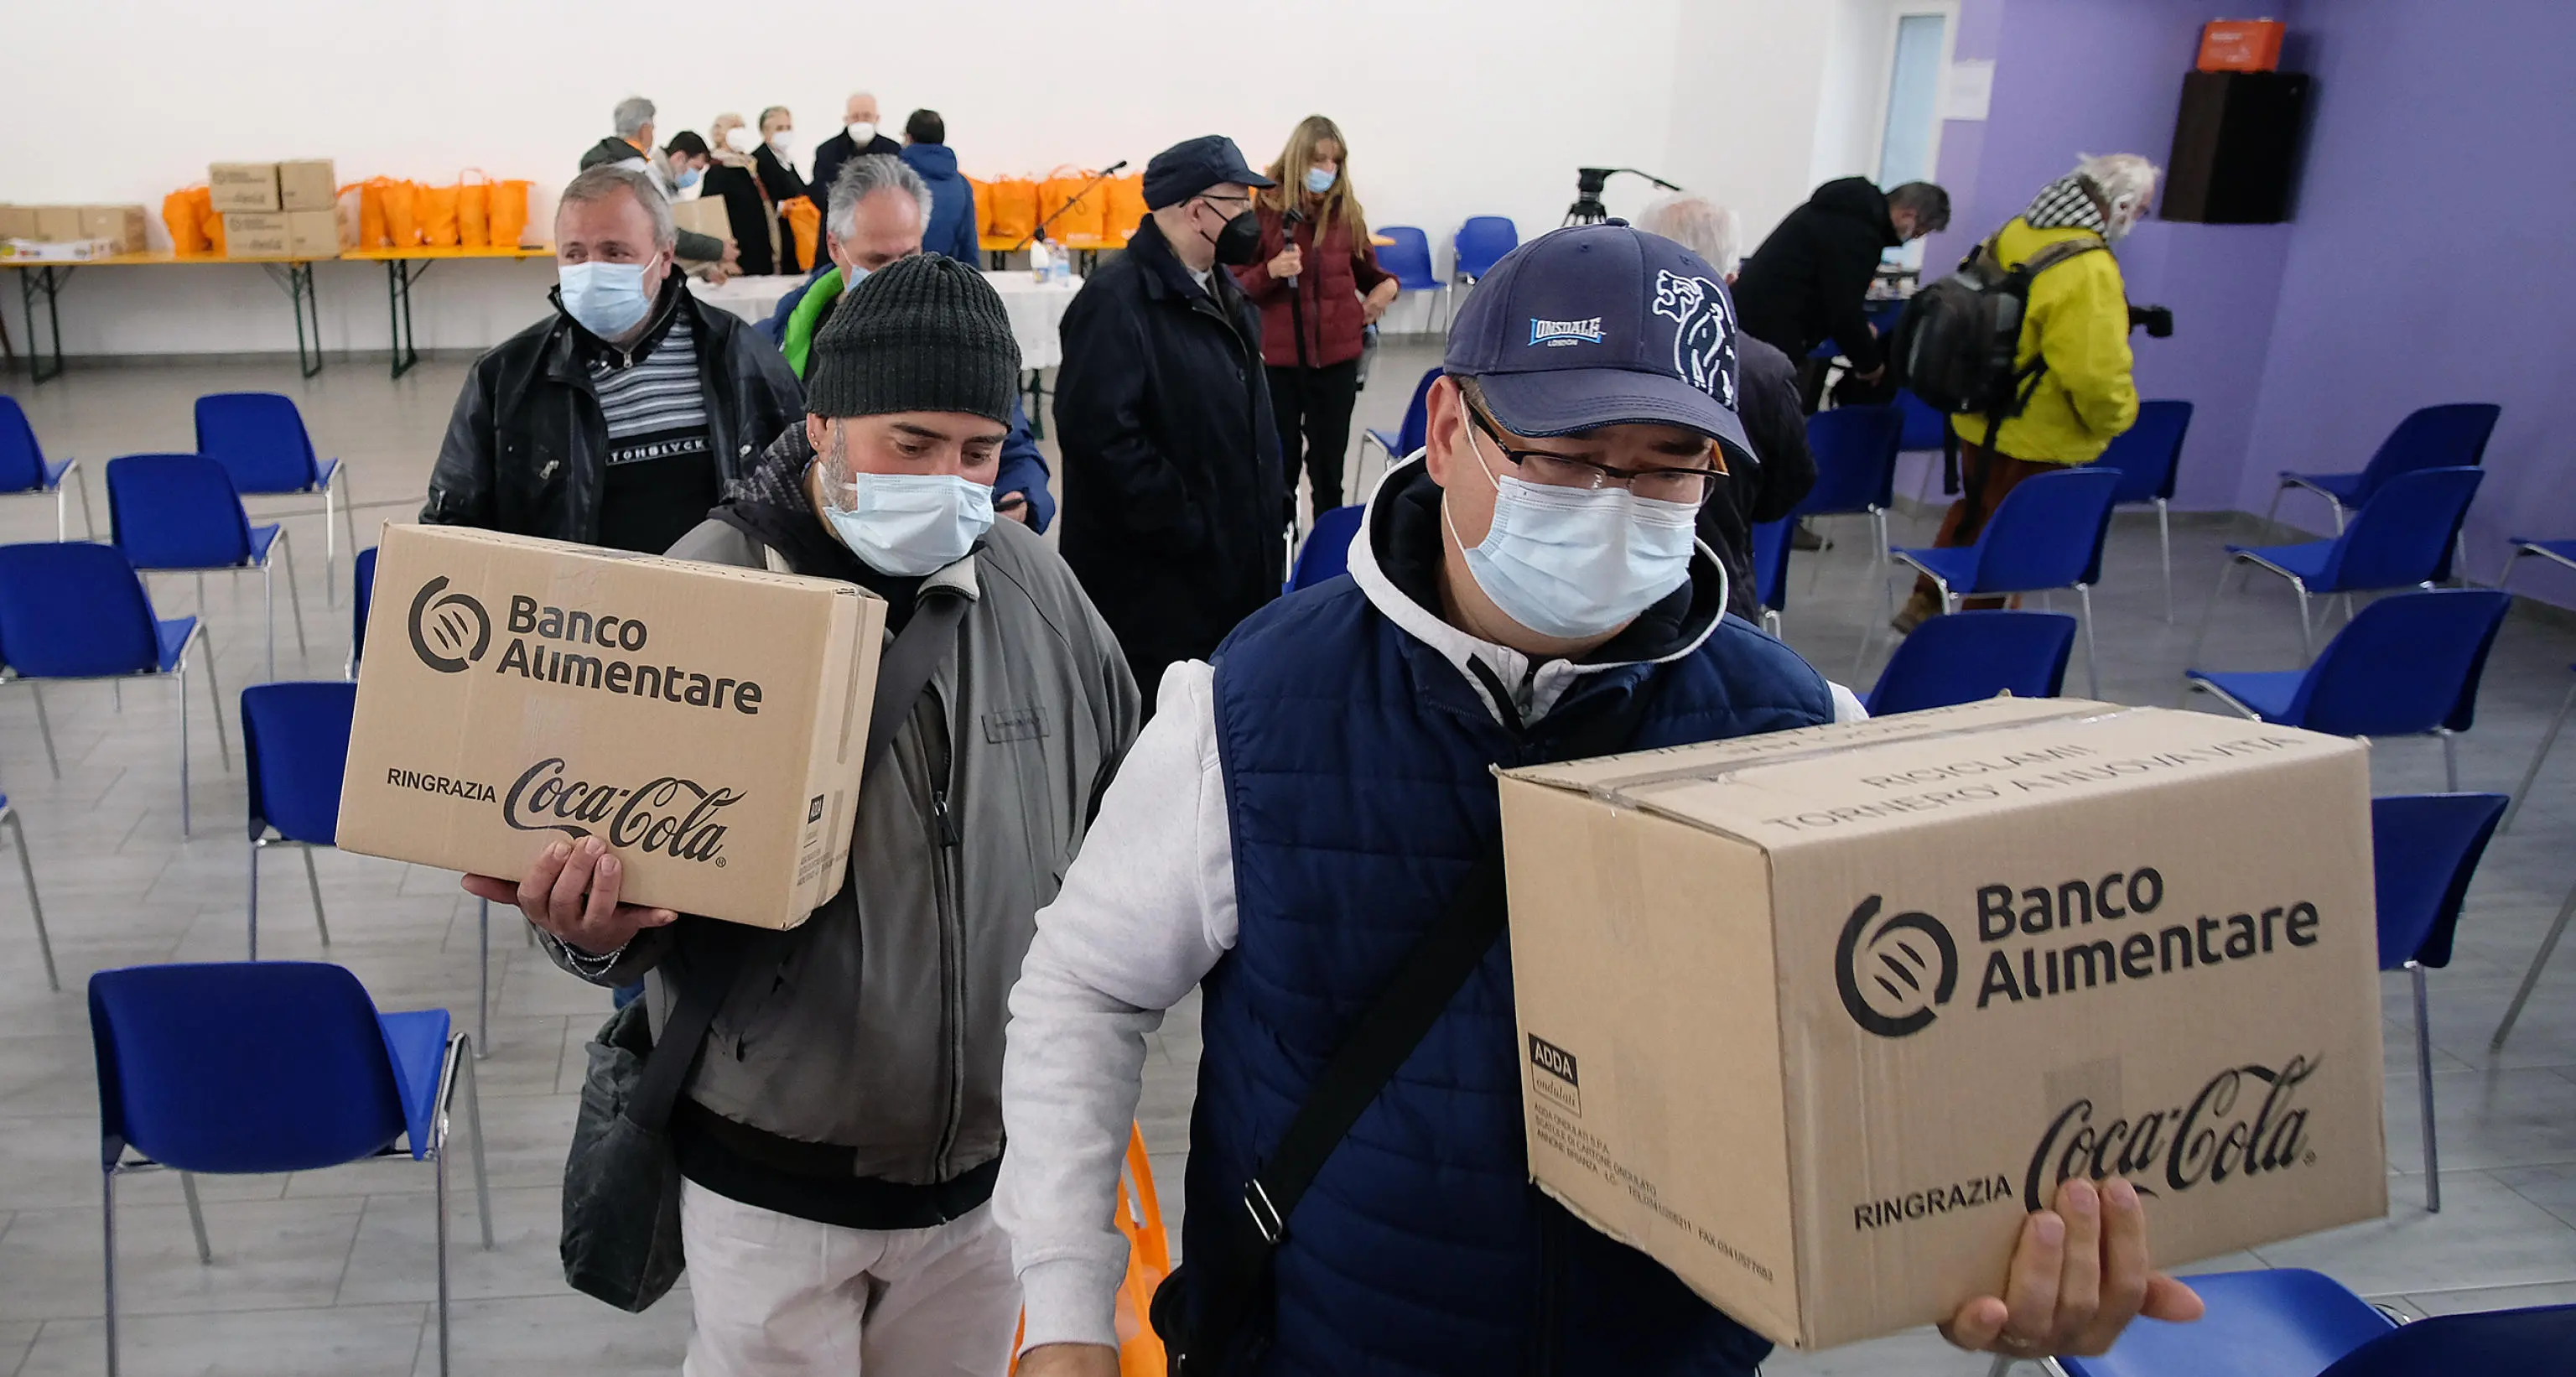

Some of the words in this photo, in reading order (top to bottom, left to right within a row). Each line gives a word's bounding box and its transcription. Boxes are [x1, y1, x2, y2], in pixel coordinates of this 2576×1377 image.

[1528, 316, 1607, 346] LONSDALE
[506, 595, 647, 651] Banco
[496, 639, 763, 715] Alimentare
[387, 767, 496, 803] RINGRAZIA
[503, 756, 746, 863] Coca-Cola
[1976, 866, 2163, 941] Banco
[1976, 899, 2319, 1008] Alimentare
[1535, 1041, 1573, 1081] ADDA
[1536, 1079, 1576, 1106] ondulati
[1853, 1173, 2012, 1232] RINGRAZIA
